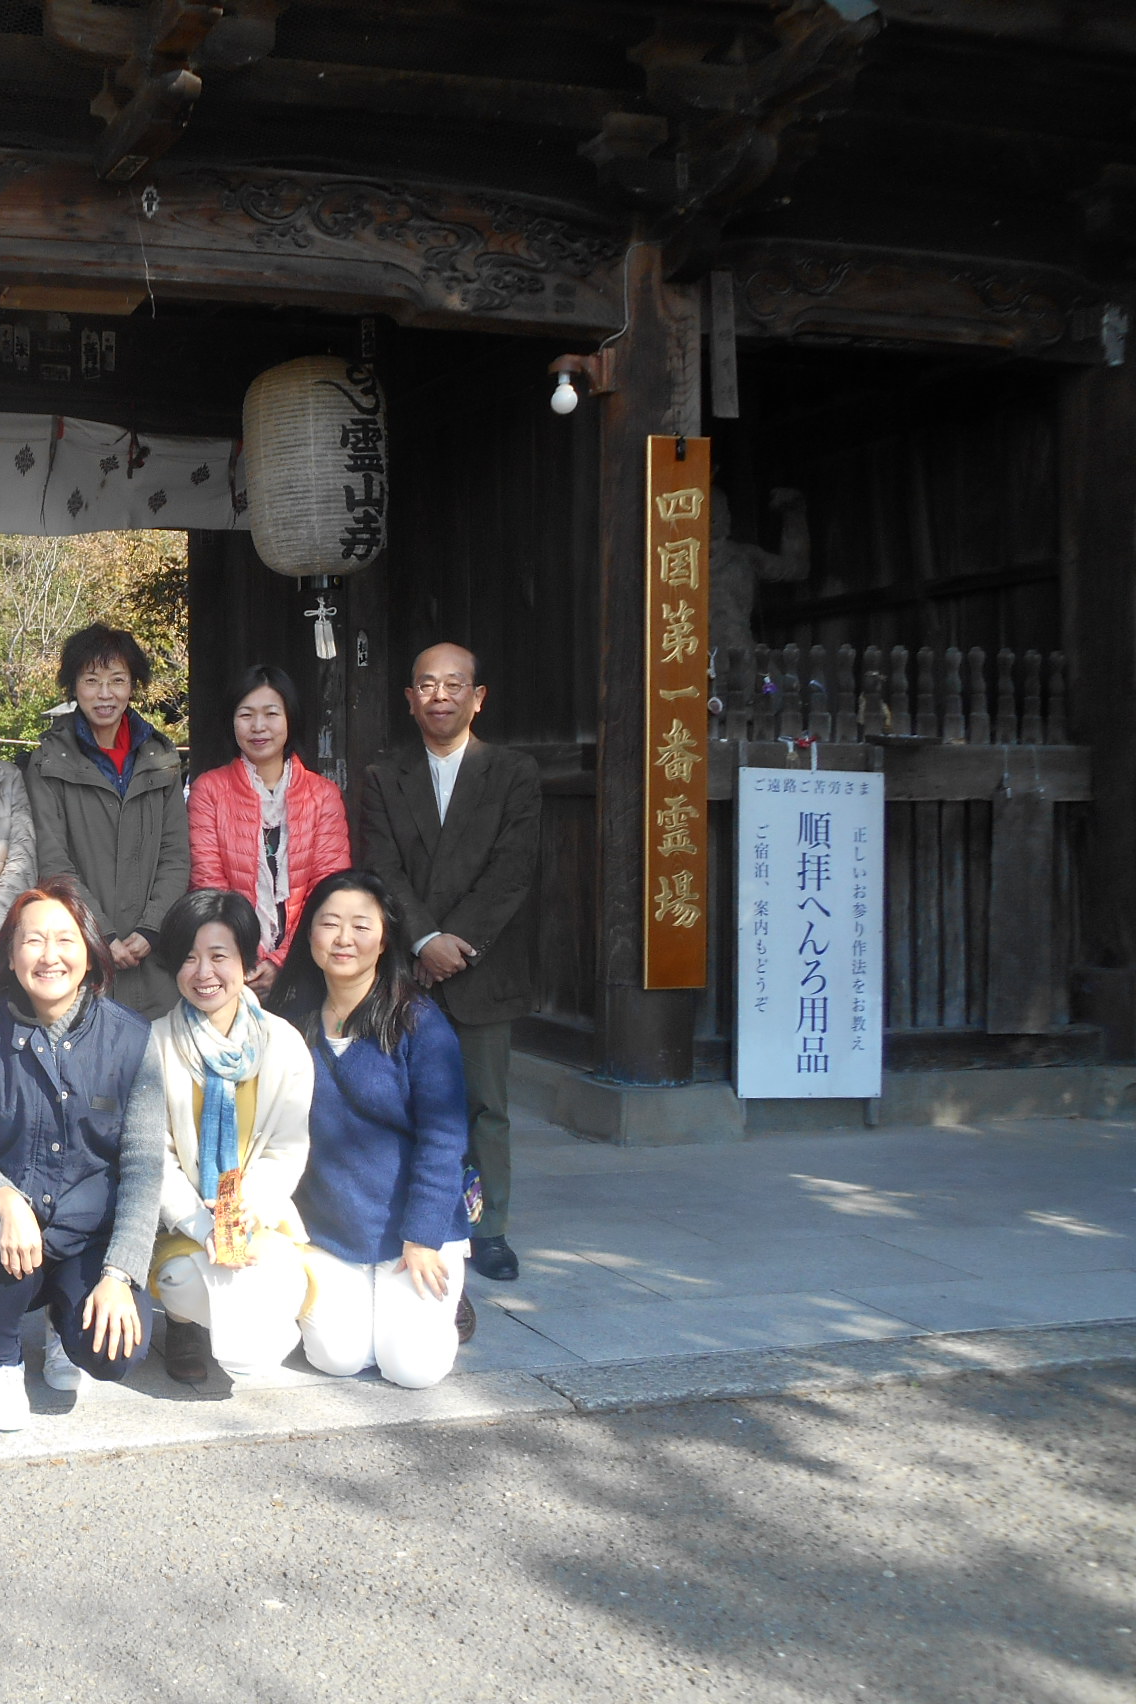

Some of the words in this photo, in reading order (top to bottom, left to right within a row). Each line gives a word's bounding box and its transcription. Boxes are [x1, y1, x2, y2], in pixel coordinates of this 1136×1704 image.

[655, 487, 704, 928] 四国第一番霊場
[754, 778, 870, 797] ご遠路ご苦労さま
[796, 811, 832, 1074] 順拝へんろ用品
[851, 826, 868, 1051] 正しいお参り作法をお教え
